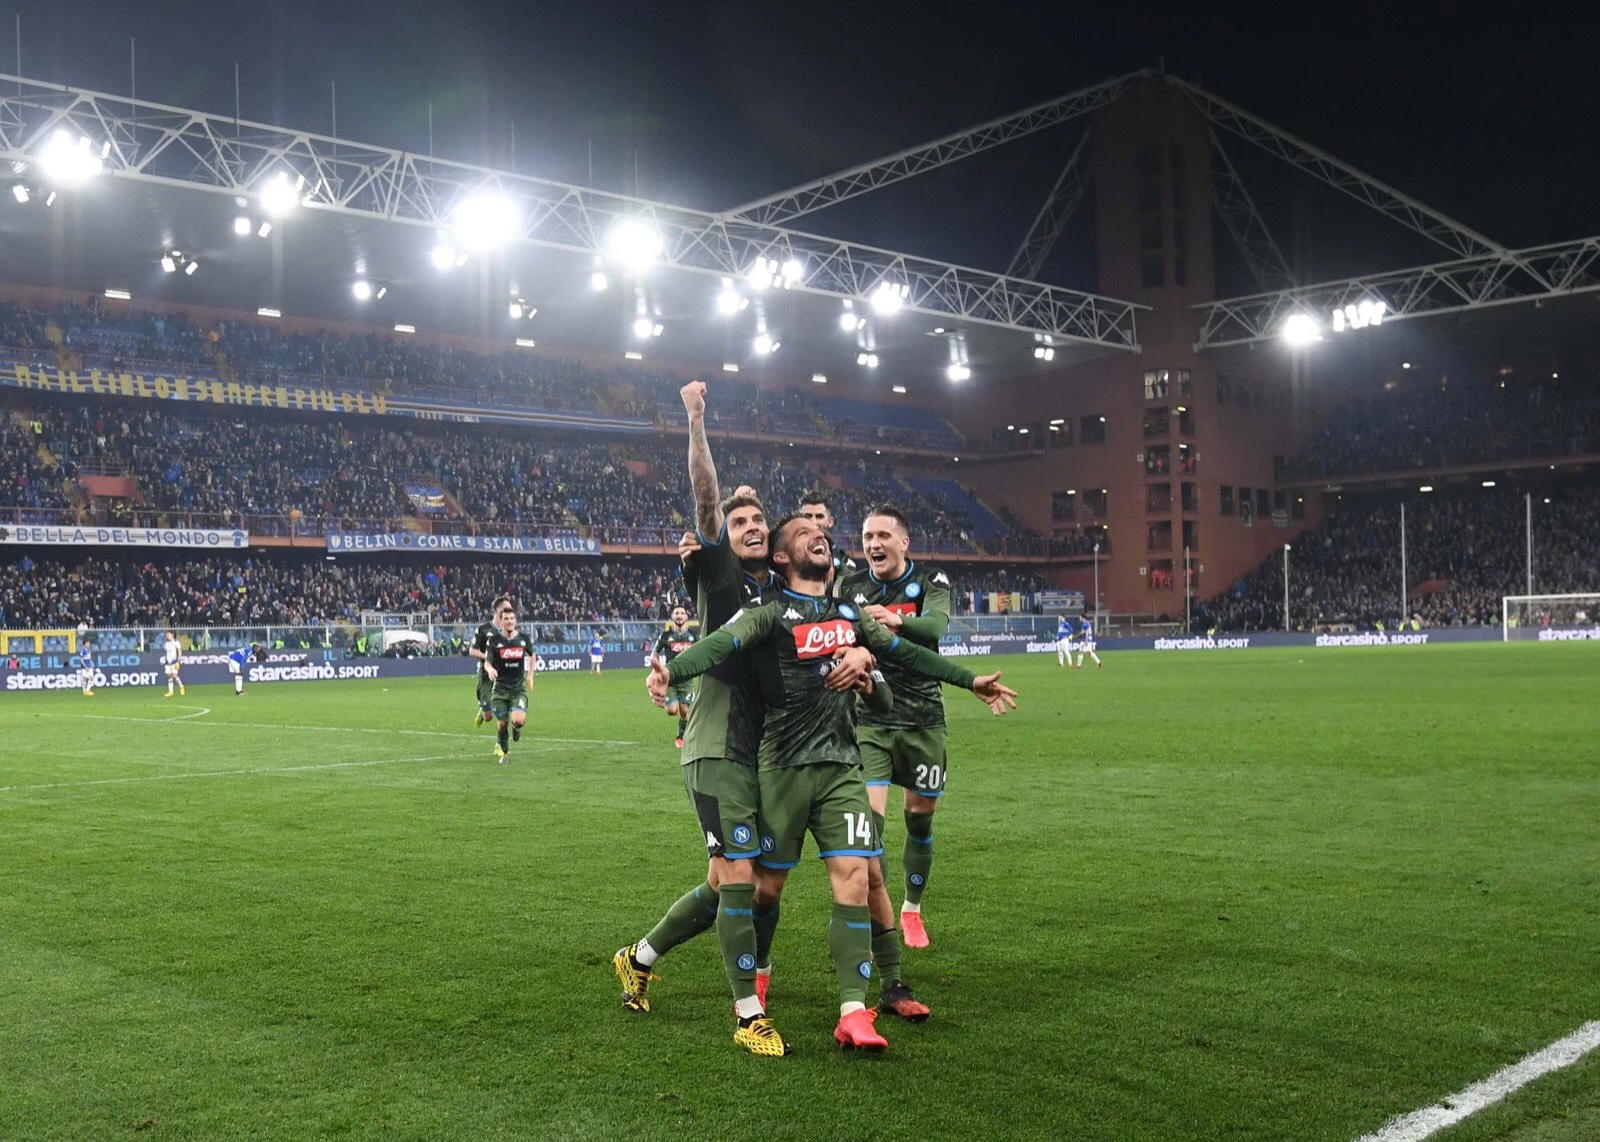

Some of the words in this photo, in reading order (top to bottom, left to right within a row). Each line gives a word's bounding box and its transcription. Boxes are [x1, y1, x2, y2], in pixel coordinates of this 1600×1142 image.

[195, 380, 288, 408] SEMPRE
[16, 527, 87, 543] BELLA
[97, 529, 137, 544] DEL
[146, 530, 221, 546] MONDO
[344, 535, 397, 549] BELIN
[418, 536, 463, 549] COME
[483, 537, 524, 551] SIAM
[544, 538, 585, 551] BELLI
[797, 624, 857, 654] Lete
[69, 655, 141, 669] CLCIO
[6, 668, 158, 690] starcasiò.SPORT
[915, 763, 941, 790] 20
[844, 812, 871, 846] 14
